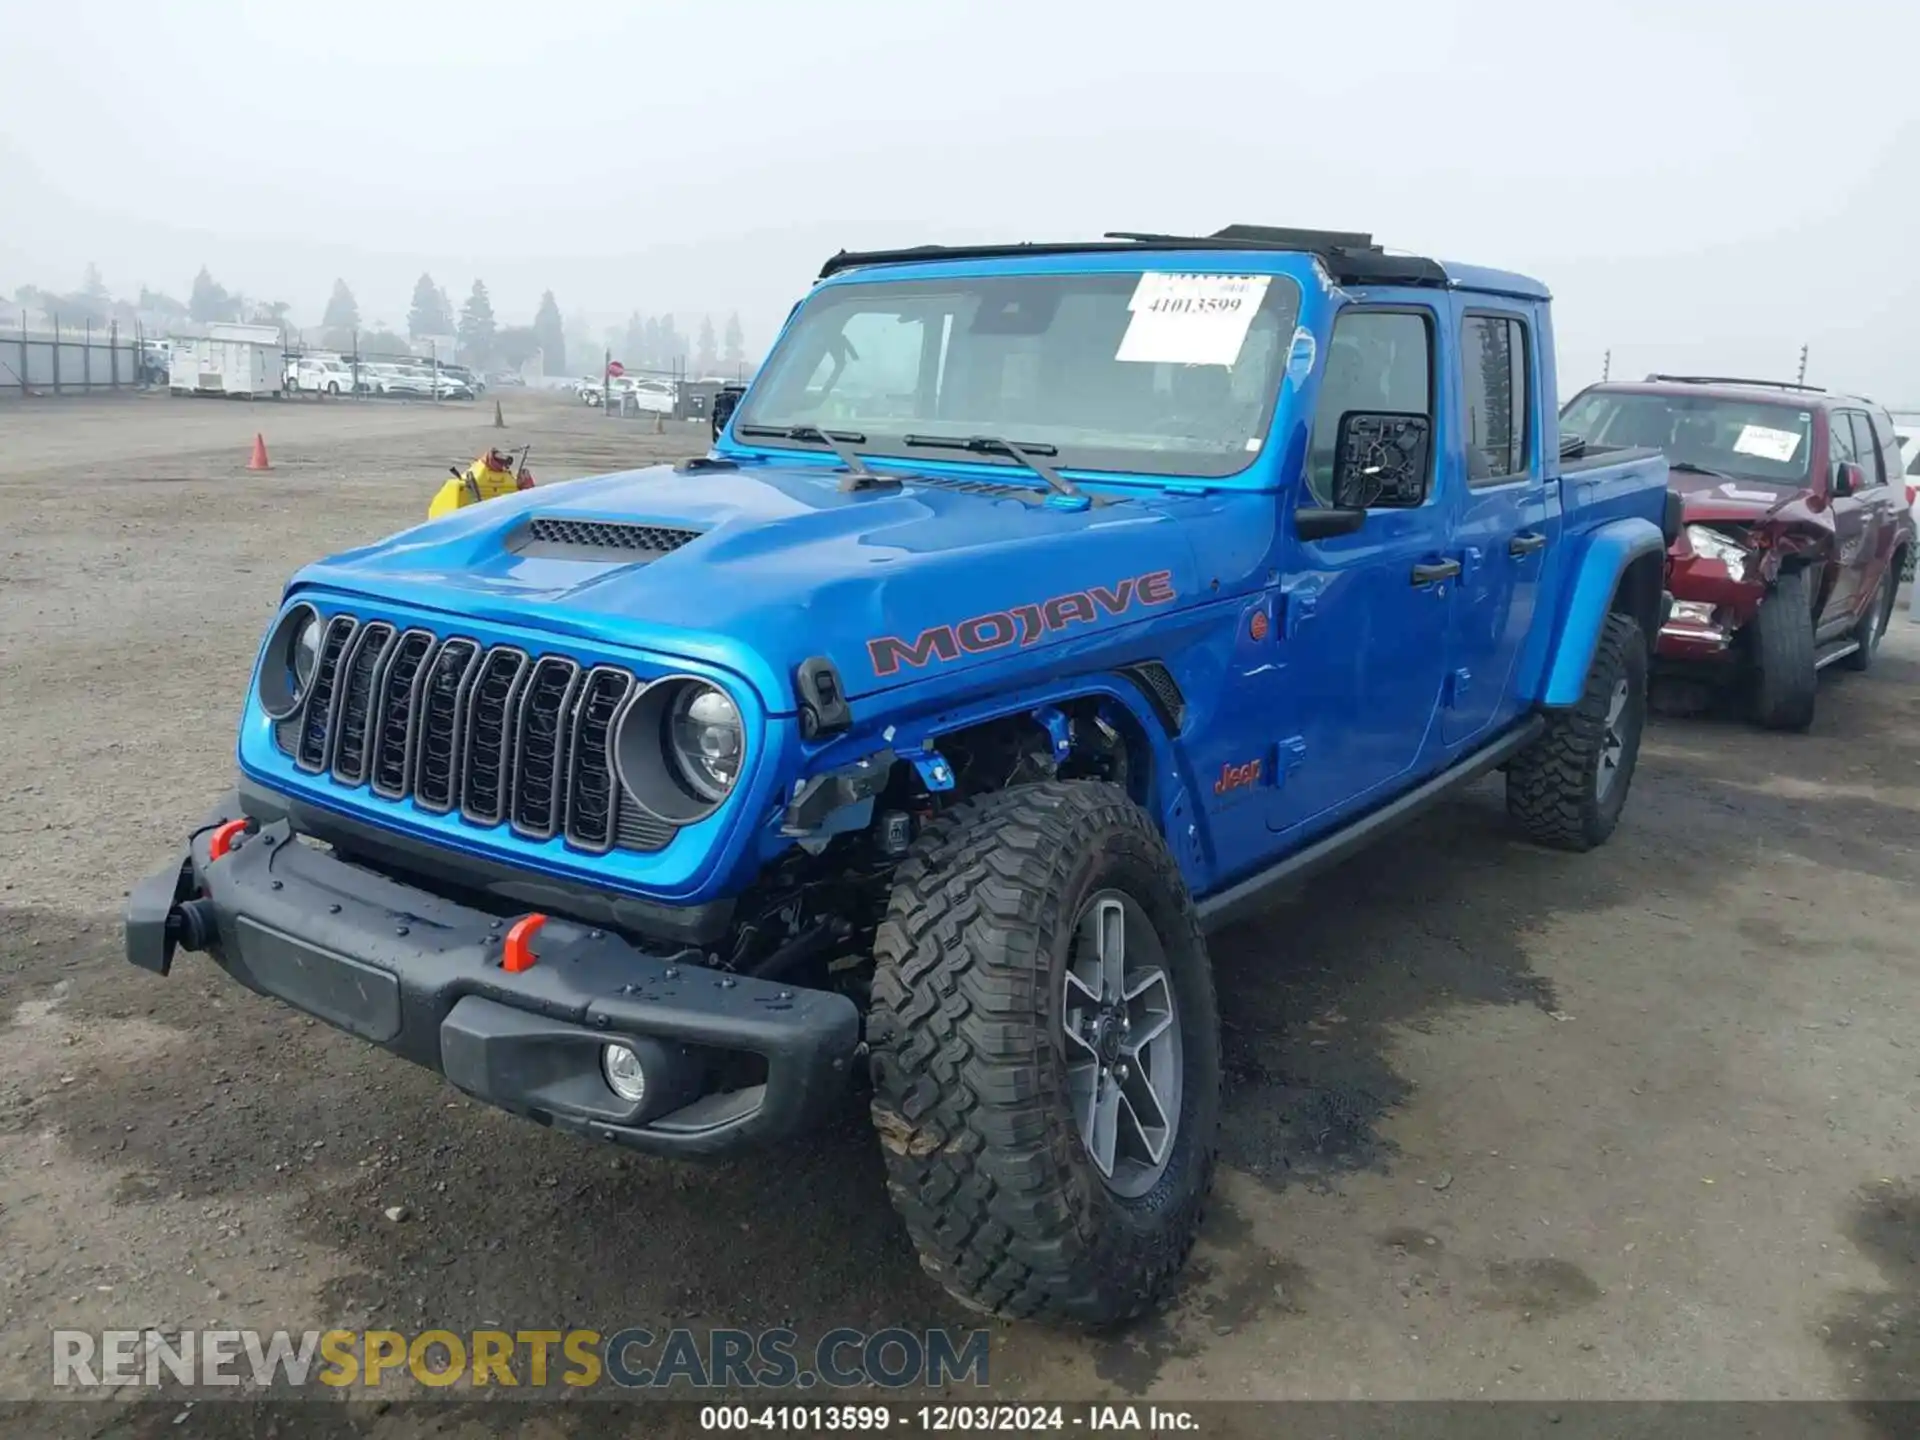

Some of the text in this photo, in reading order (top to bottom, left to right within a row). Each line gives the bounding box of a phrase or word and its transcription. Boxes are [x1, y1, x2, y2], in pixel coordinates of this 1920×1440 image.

[1148, 298, 1243, 313] 41013599
[866, 570, 1176, 677] MOJAVE
[1214, 759, 1262, 795] Jeep
